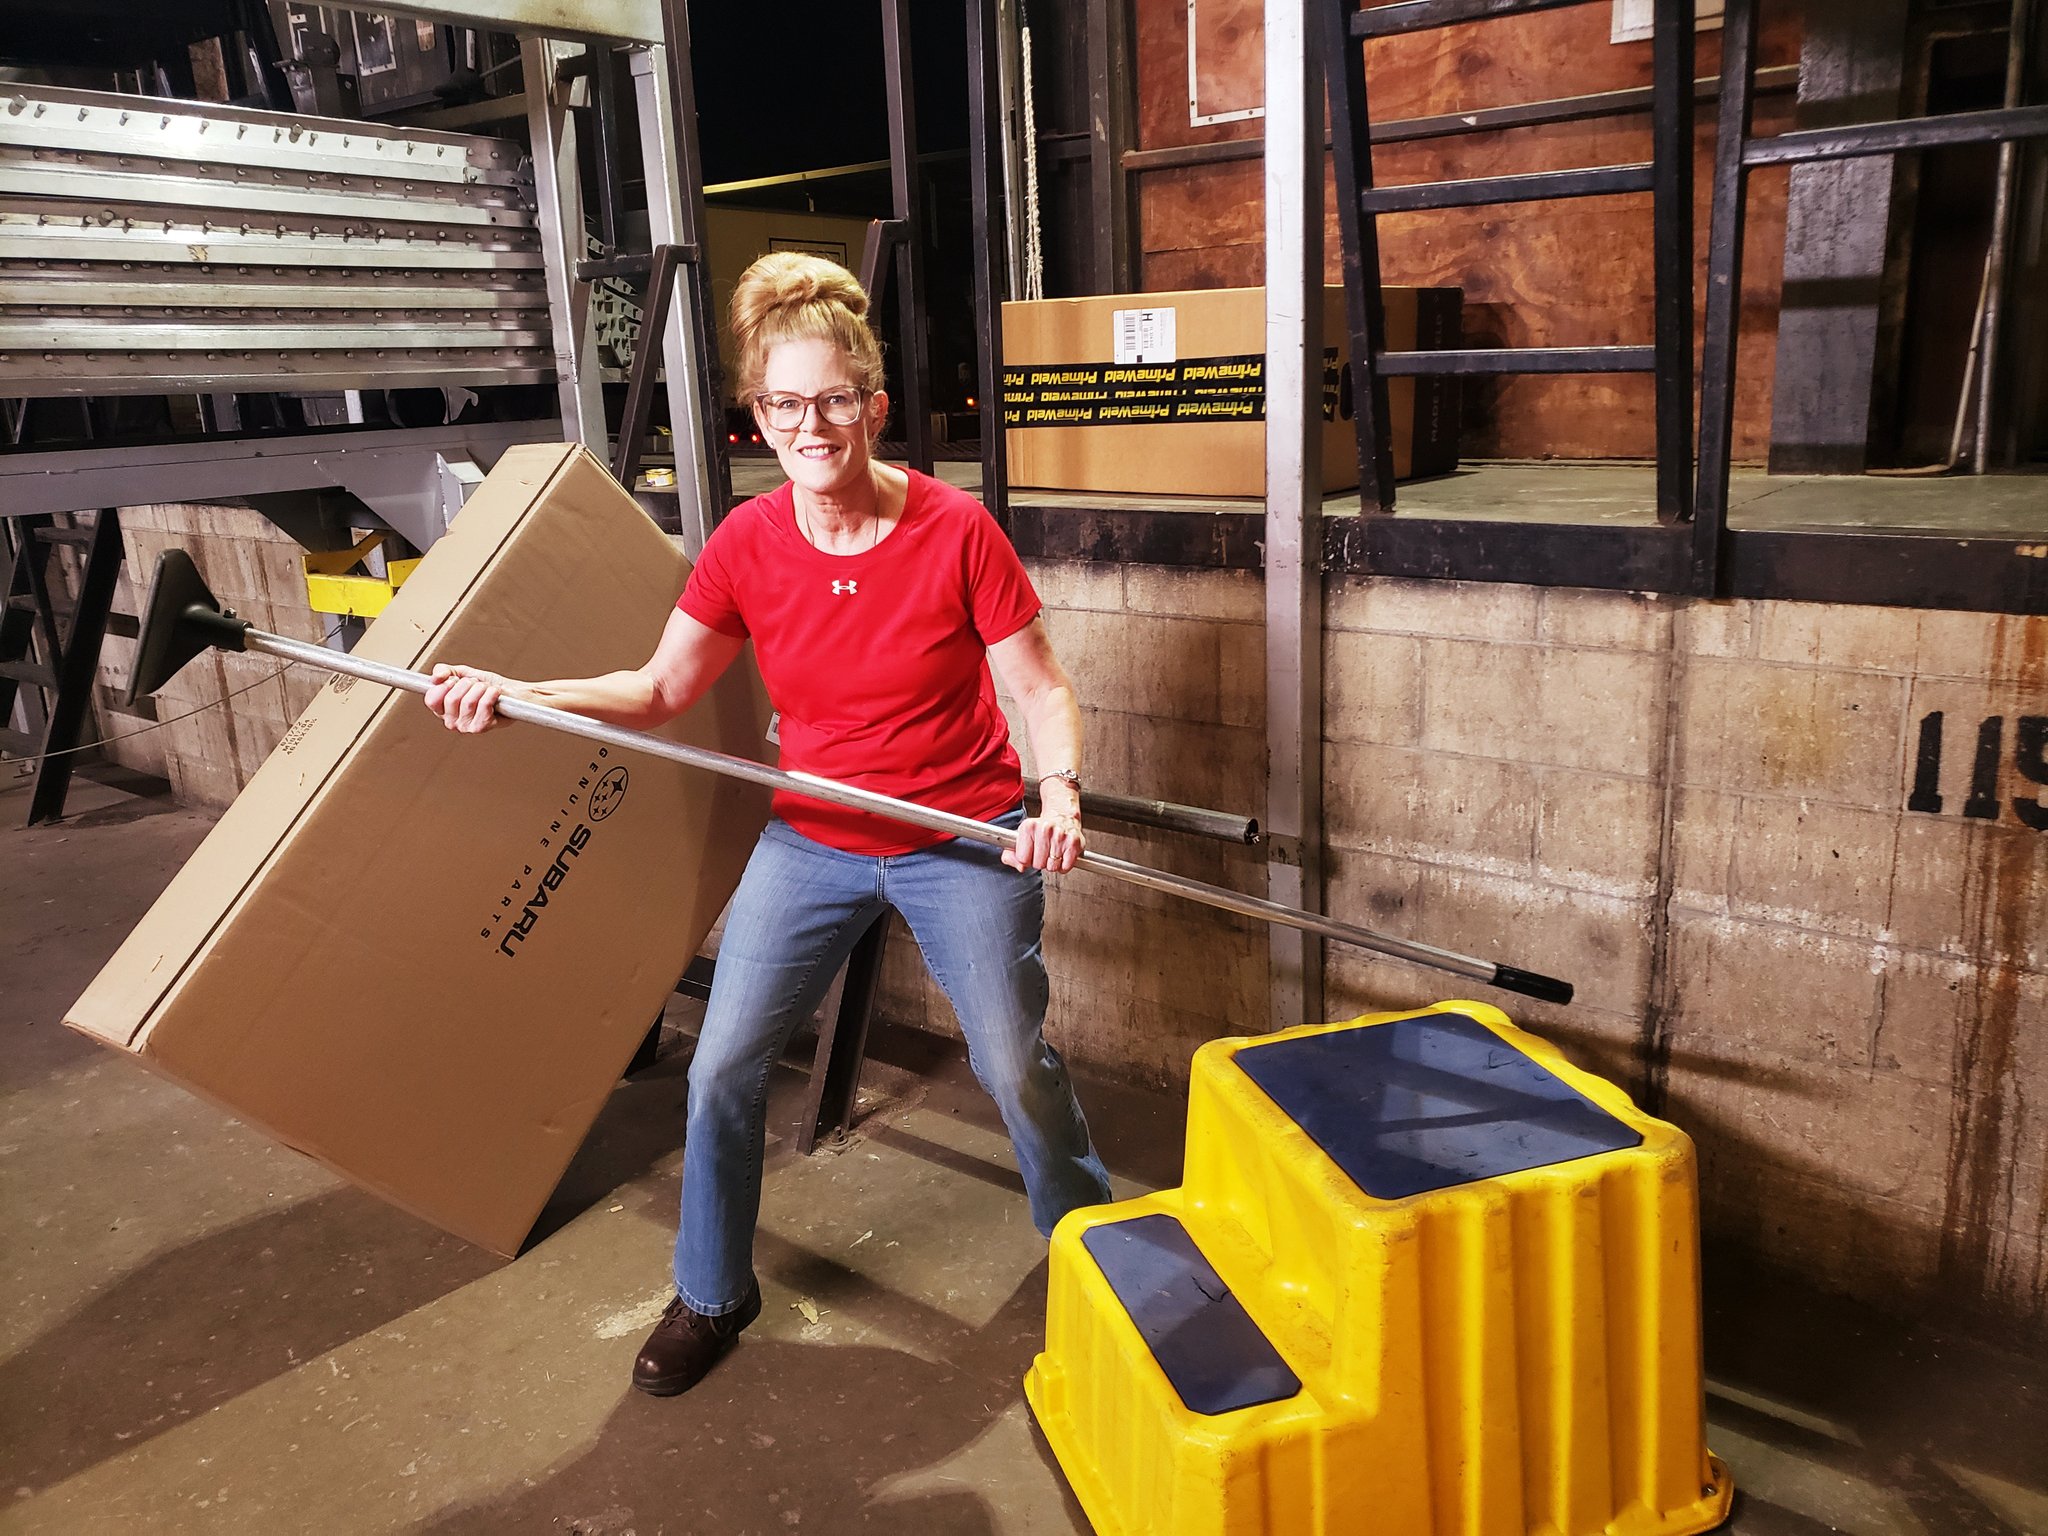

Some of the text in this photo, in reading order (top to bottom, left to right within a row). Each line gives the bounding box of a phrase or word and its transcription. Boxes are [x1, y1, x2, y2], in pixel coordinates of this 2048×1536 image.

[1031, 371, 1098, 386] PrimeWeld
[1104, 368, 1176, 383] PrimeWeld
[1183, 363, 1261, 381] PrimeWeld
[1027, 407, 1092, 422] PrimeWeld
[1099, 404, 1170, 419] PrimeWeld
[1177, 401, 1254, 416] PrimeWeld
[481, 748, 608, 938] GENUINE PARTS
[500, 823, 592, 957] SUBARU
